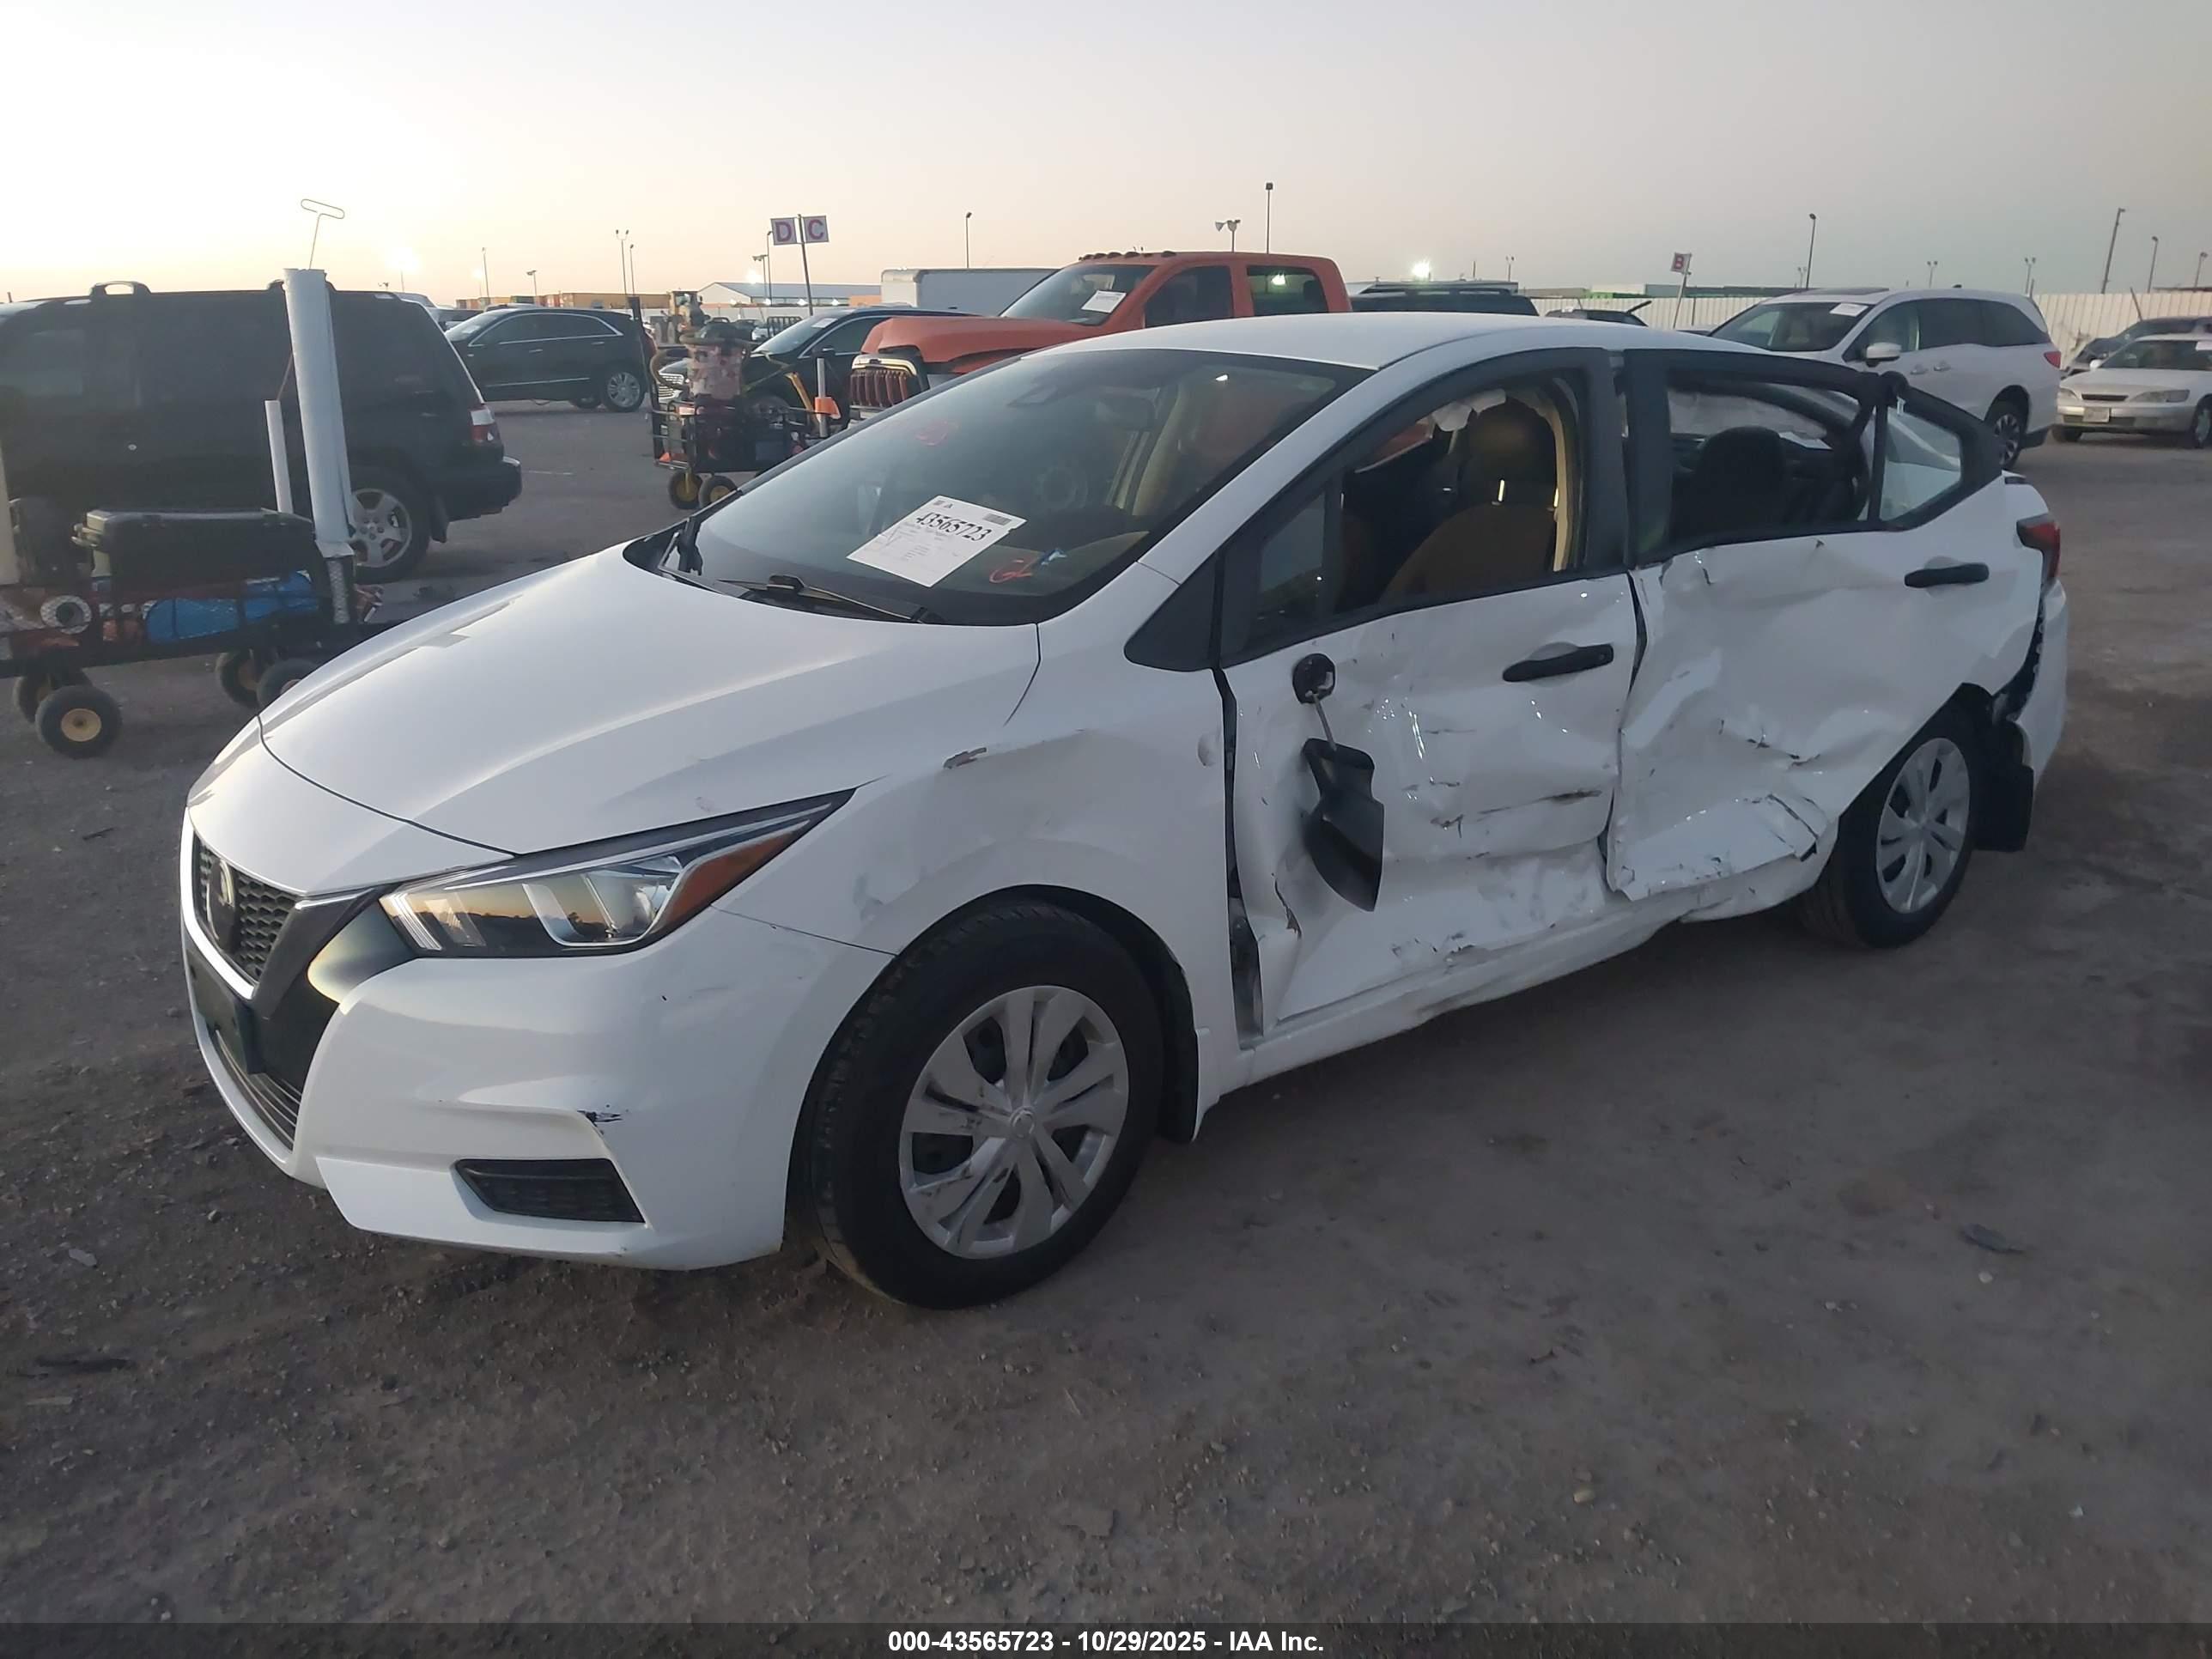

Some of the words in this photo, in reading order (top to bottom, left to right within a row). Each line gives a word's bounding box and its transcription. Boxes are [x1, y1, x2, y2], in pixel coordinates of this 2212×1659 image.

[775, 221, 792, 242] D
[808, 219, 824, 240] C
[1674, 255, 1685, 270] B
[915, 512, 992, 542] 43565723
